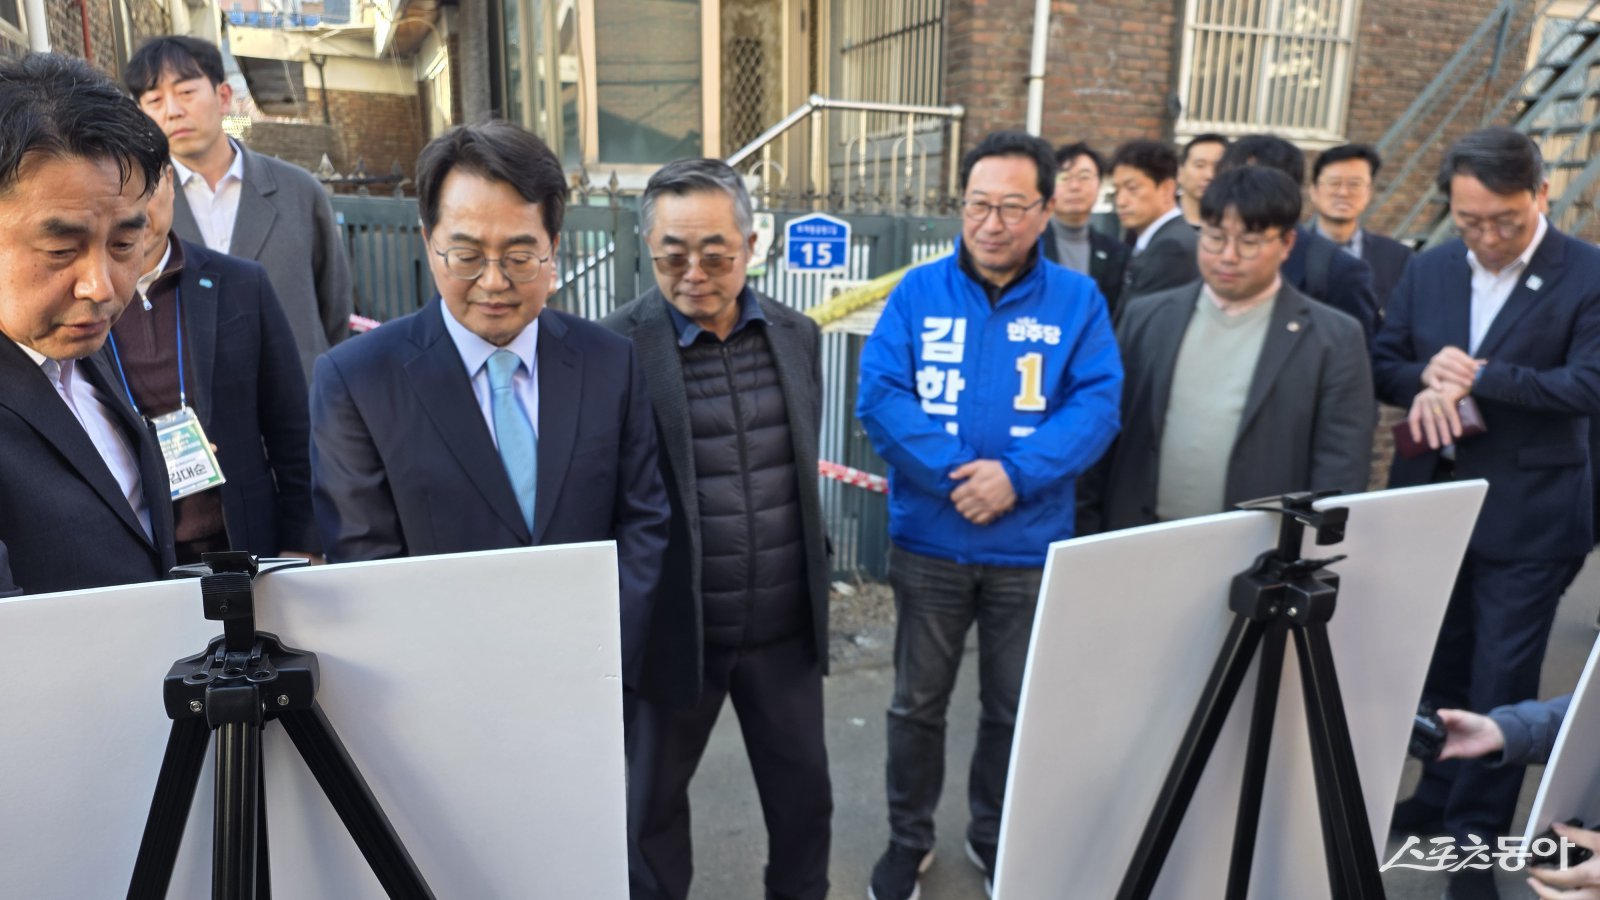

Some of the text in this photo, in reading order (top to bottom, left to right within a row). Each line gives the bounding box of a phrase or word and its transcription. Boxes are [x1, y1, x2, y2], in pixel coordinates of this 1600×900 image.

[801, 242, 832, 266] 15
[1006, 322, 1062, 345] 민주당
[915, 316, 967, 436] 김한
[1013, 352, 1047, 411] 1
